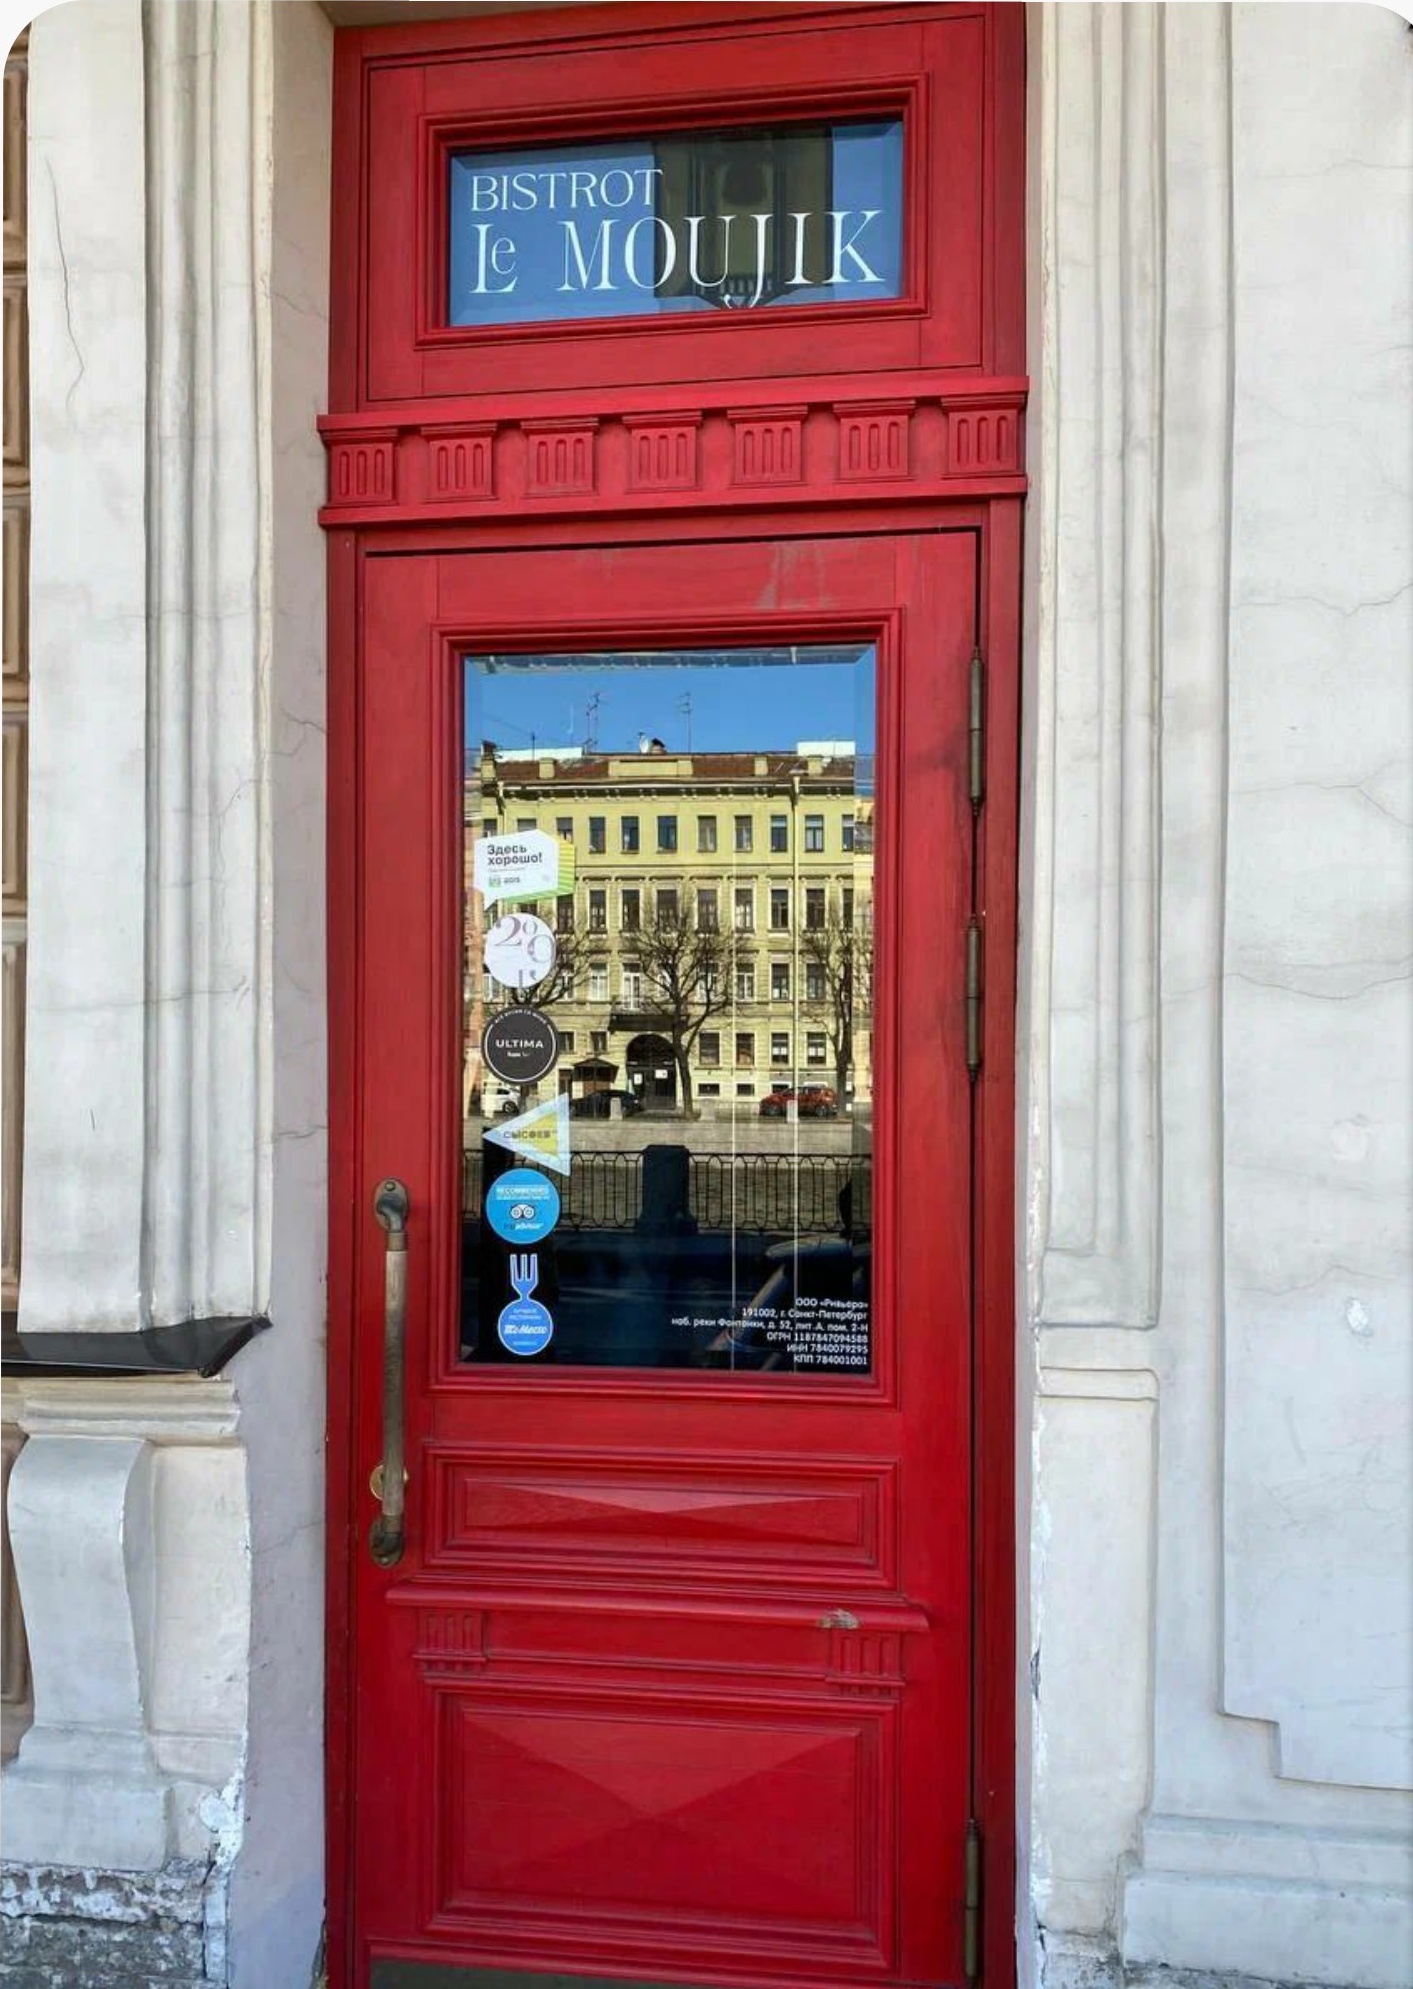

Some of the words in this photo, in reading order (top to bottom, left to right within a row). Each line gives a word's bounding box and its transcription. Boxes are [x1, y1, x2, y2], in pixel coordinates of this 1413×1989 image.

[470, 168, 663, 212] BISTROT
[469, 222, 518, 295] Le
[556, 209, 887, 310] MOUJIK
[487, 844, 527, 856] Здесь
[487, 852, 543, 867] хорошо!
[495, 1038, 544, 1049] ULTIMA
[795, 1297, 818, 1307] ООО
[742, 1307, 778, 1318] 191002,
[788, 1308, 867, 1321] Санкт-Петербург
[693, 1319, 716, 1328] реки
[767, 1331, 792, 1341] ОГРН
[786, 1343, 809, 1352] ИНН
[793, 1354, 814, 1363] КПП
[816, 1355, 868, 1365] 784001001
